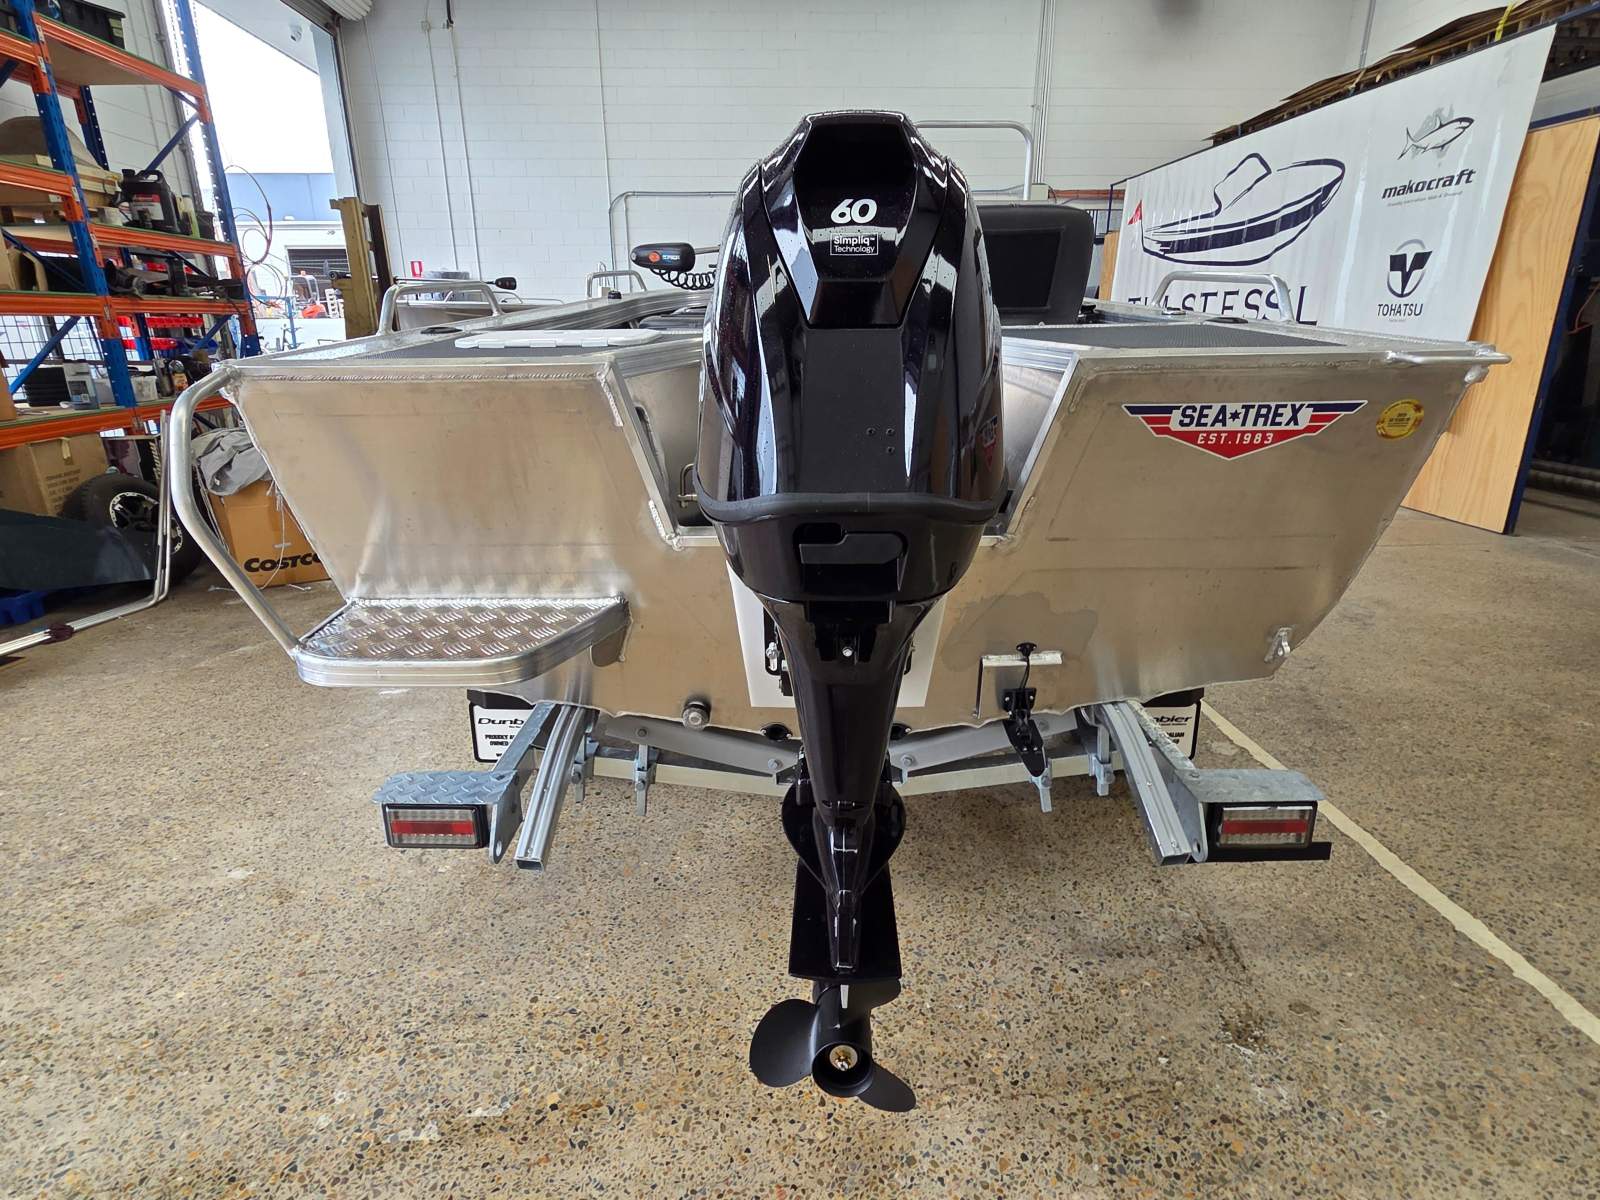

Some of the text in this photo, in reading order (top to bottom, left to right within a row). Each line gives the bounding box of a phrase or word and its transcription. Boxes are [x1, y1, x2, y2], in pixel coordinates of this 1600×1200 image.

[1381, 168, 1476, 199] makocraft
[830, 198, 878, 224] 60
[834, 245, 875, 254] Technology
[1377, 303, 1424, 317] TOHATSU
[478, 717, 525, 725] Dunb
